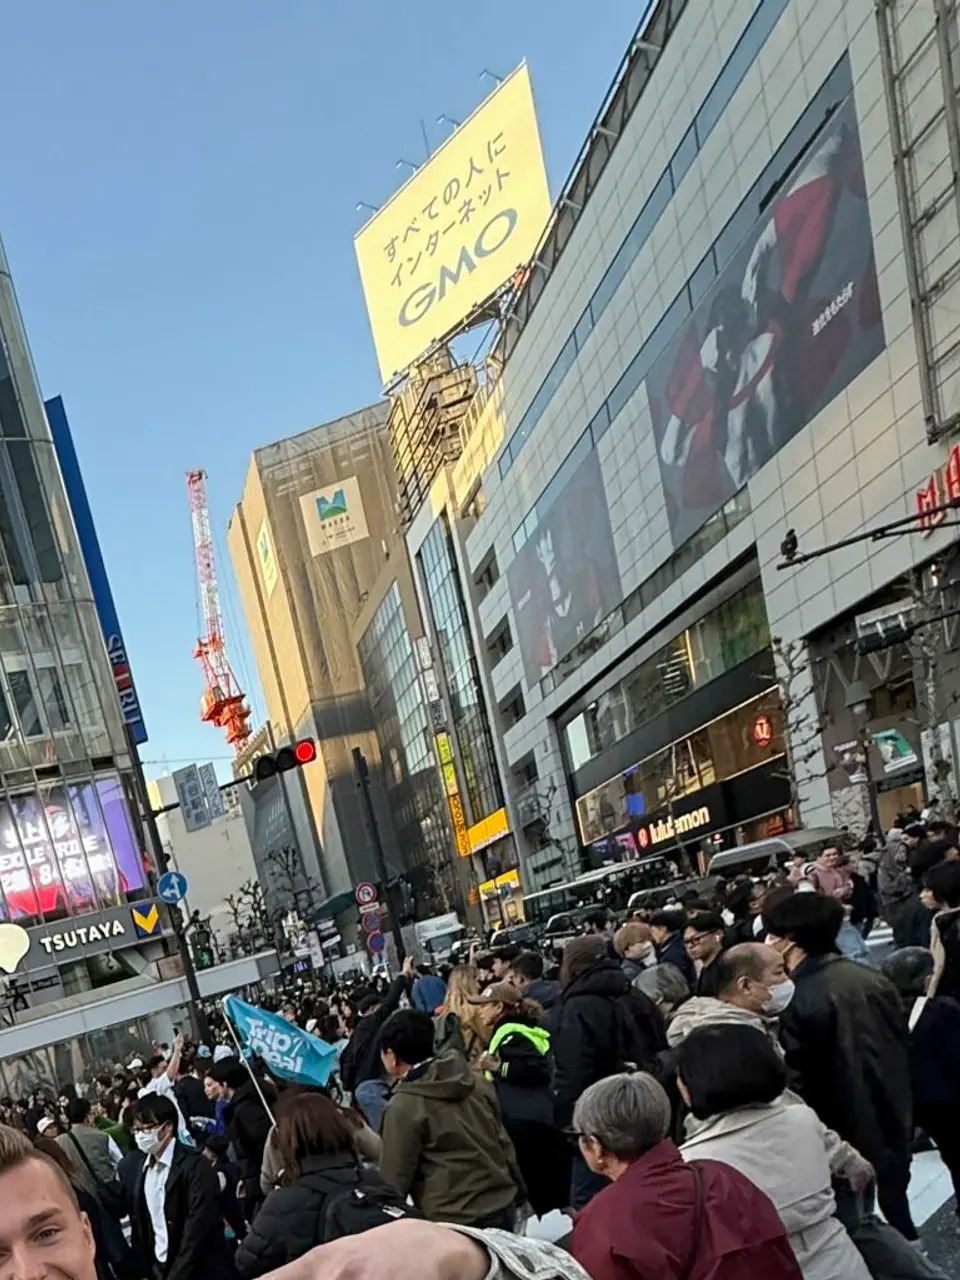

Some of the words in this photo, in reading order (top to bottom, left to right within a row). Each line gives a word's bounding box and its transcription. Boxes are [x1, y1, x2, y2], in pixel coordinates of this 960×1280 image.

[383, 132, 507, 263] すべての人に
[391, 168, 510, 287] インターネット
[398, 207, 518, 327] GMO
[40, 919, 125, 953] TSUTAYA
